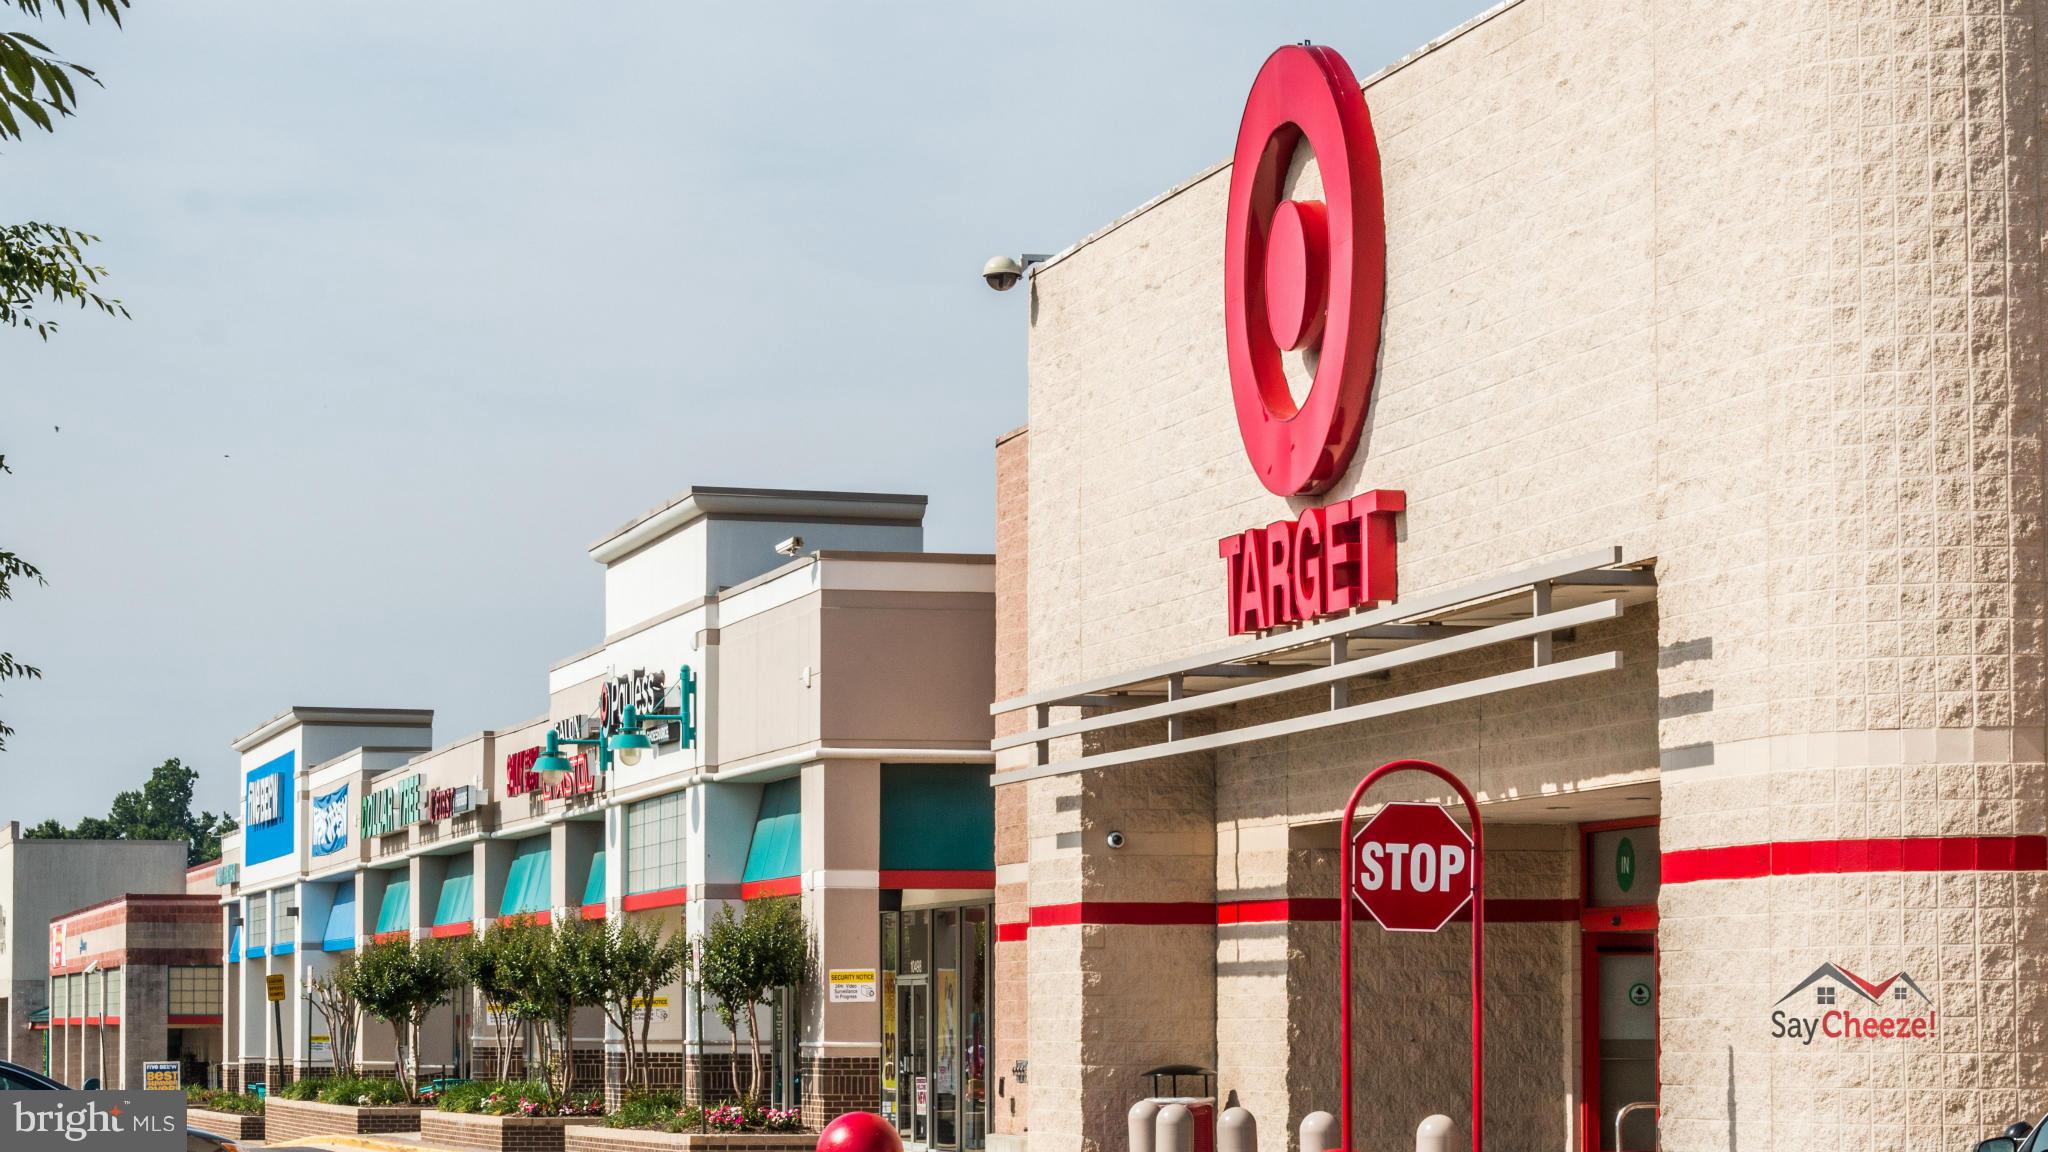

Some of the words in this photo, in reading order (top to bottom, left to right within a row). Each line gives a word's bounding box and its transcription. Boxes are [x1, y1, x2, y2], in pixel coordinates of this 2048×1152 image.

[1219, 489, 1392, 636] TARGET
[554, 715, 581, 740] SALON
[361, 787, 394, 839] DOLLAR
[398, 774, 420, 826] TREE
[1361, 841, 1465, 892] STOP
[1621, 856, 1630, 874] IN
